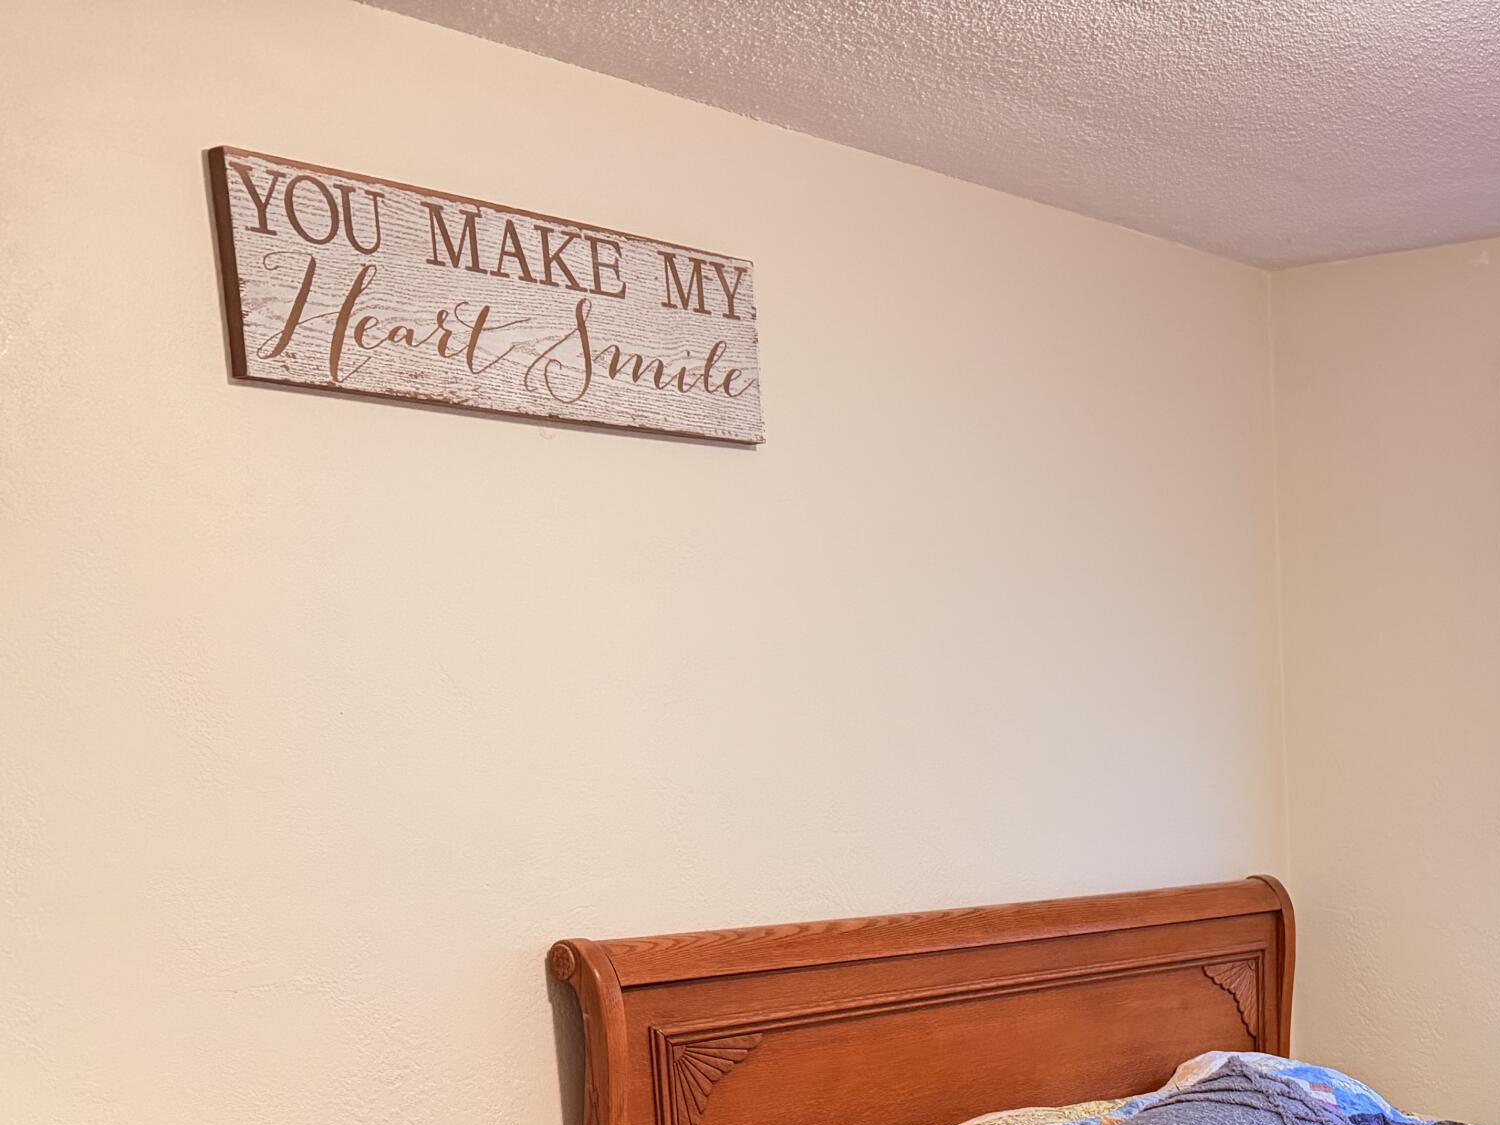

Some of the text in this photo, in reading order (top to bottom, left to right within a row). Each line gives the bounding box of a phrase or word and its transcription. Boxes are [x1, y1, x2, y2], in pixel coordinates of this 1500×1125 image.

[229, 161, 747, 320] YOU MAKE MY
[256, 250, 756, 404] Heart Smile
